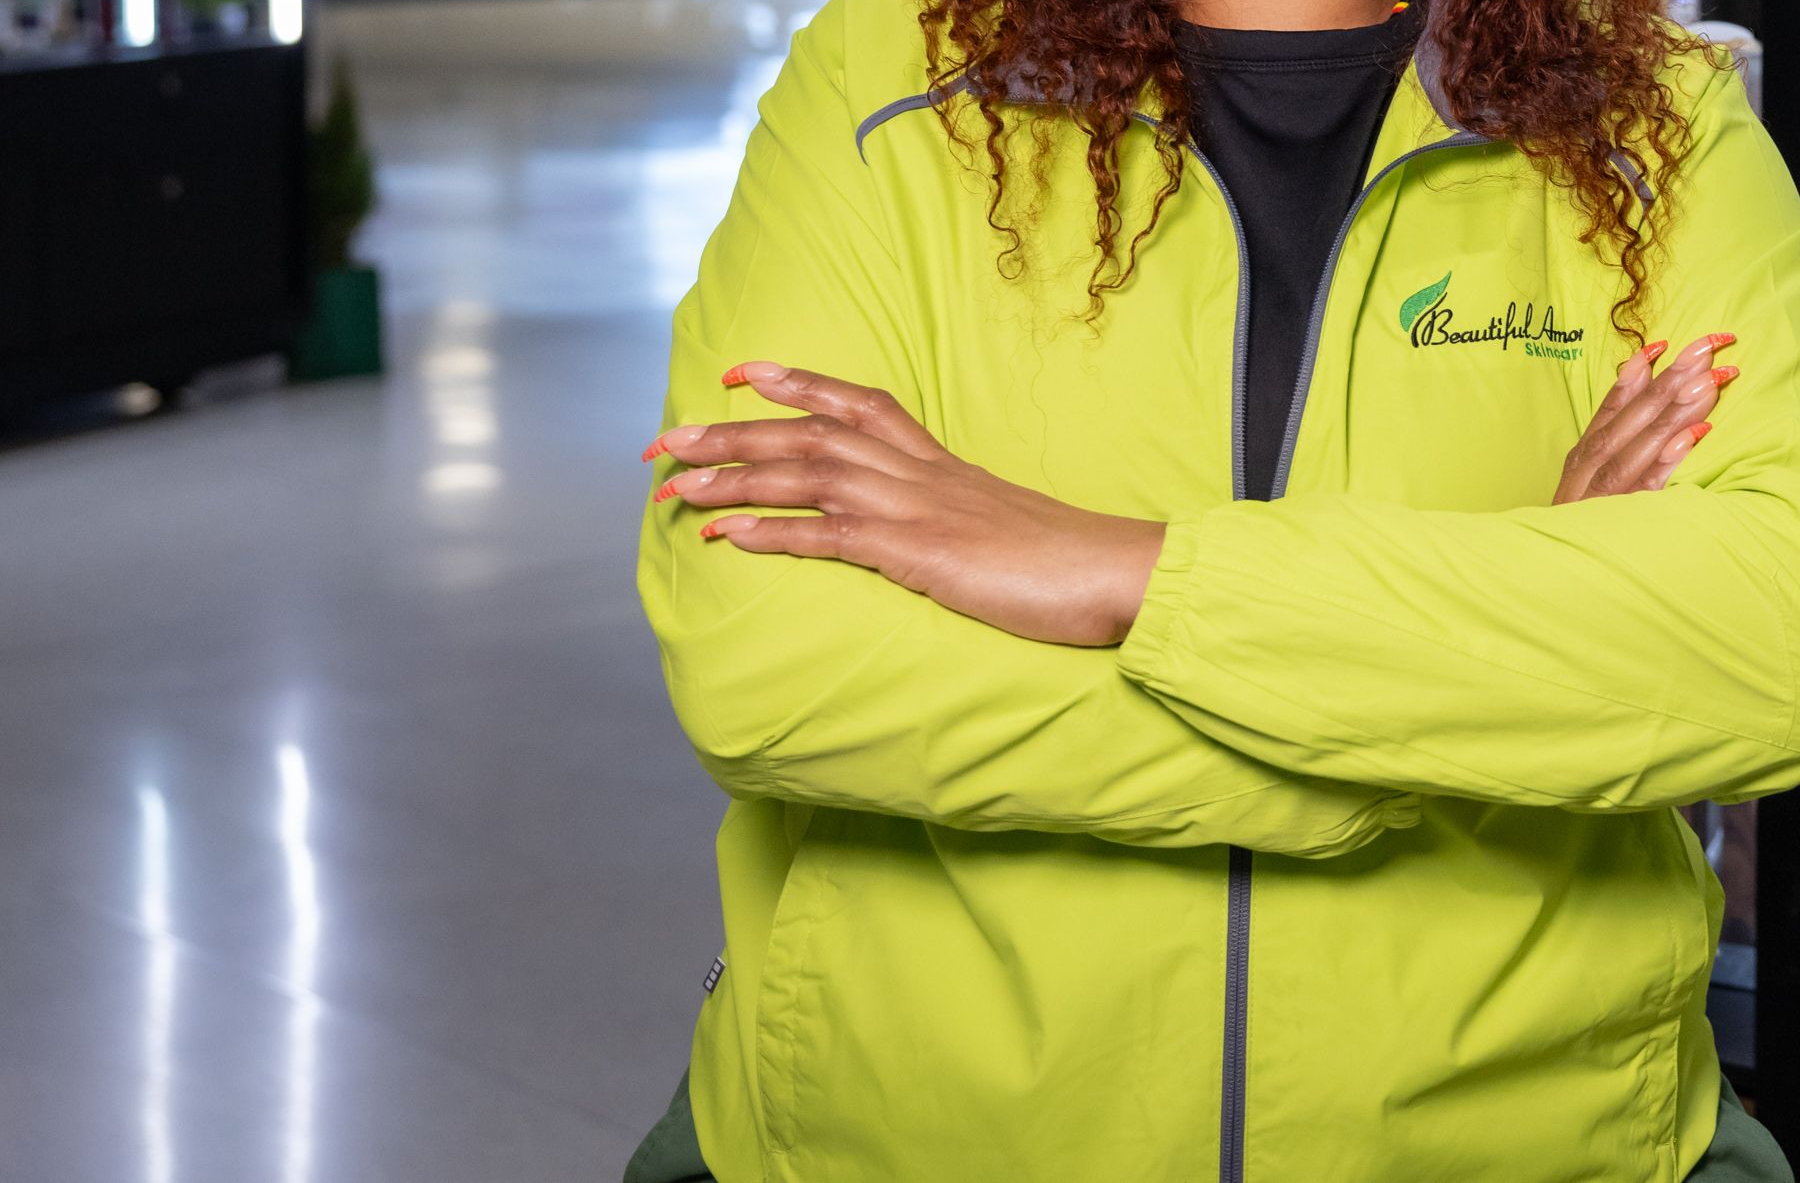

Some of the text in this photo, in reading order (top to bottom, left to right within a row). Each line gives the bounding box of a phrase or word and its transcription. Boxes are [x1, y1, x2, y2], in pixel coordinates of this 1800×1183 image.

[1417, 301, 1584, 351] Beautiful Amor
[1525, 340, 1584, 362] Skincar
